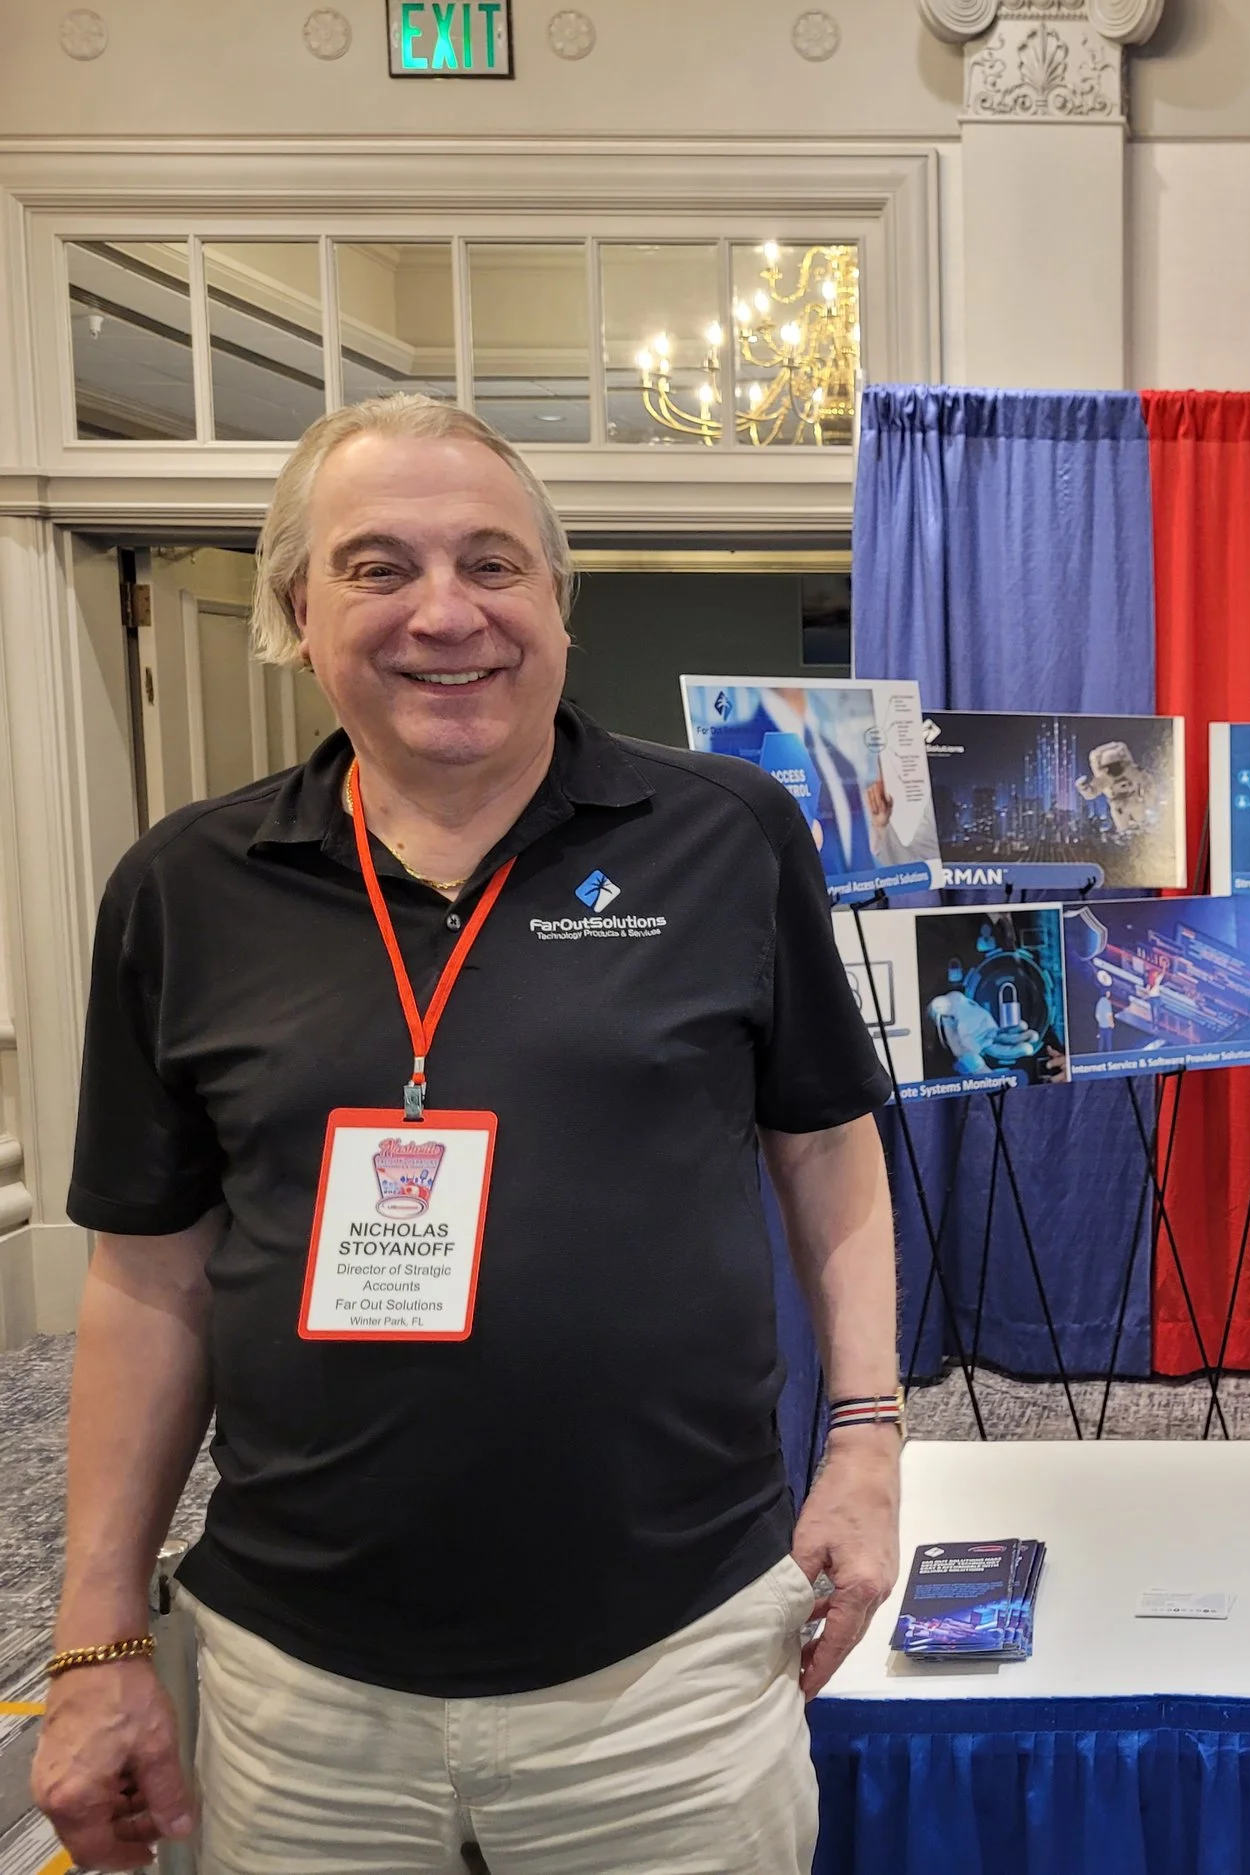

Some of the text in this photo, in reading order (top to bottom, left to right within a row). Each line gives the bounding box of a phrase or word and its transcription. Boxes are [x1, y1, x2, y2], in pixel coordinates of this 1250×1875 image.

[402, 3, 501, 69] EXIT
[853, 880, 875, 892] Access
[875, 873, 900, 888] Control
[900, 871, 929, 885] Solutions
[530, 915, 667, 932] FarOutSolutions
[537, 928, 662, 941] Technology Products & Services
[1072, 1063, 1106, 1075] Internet
[1108, 1060, 1137, 1071] Service
[1139, 1058, 1147, 1068] &
[1148, 1056, 1185, 1068] Software
[1186, 1053, 1220, 1064] Provider
[920, 1081, 961, 1098] Systems
[963, 1075, 1017, 1092] Monitoring
[349, 1222, 449, 1238] NICHOLAS
[338, 1241, 455, 1257] STOYANOFF
[337, 1263, 451, 1278] Director of Stratgic
[362, 1280, 421, 1292] Accounts
[335, 1299, 443, 1312] Far Out Solutions
[350, 1316, 424, 1328] Winter Park, FL
